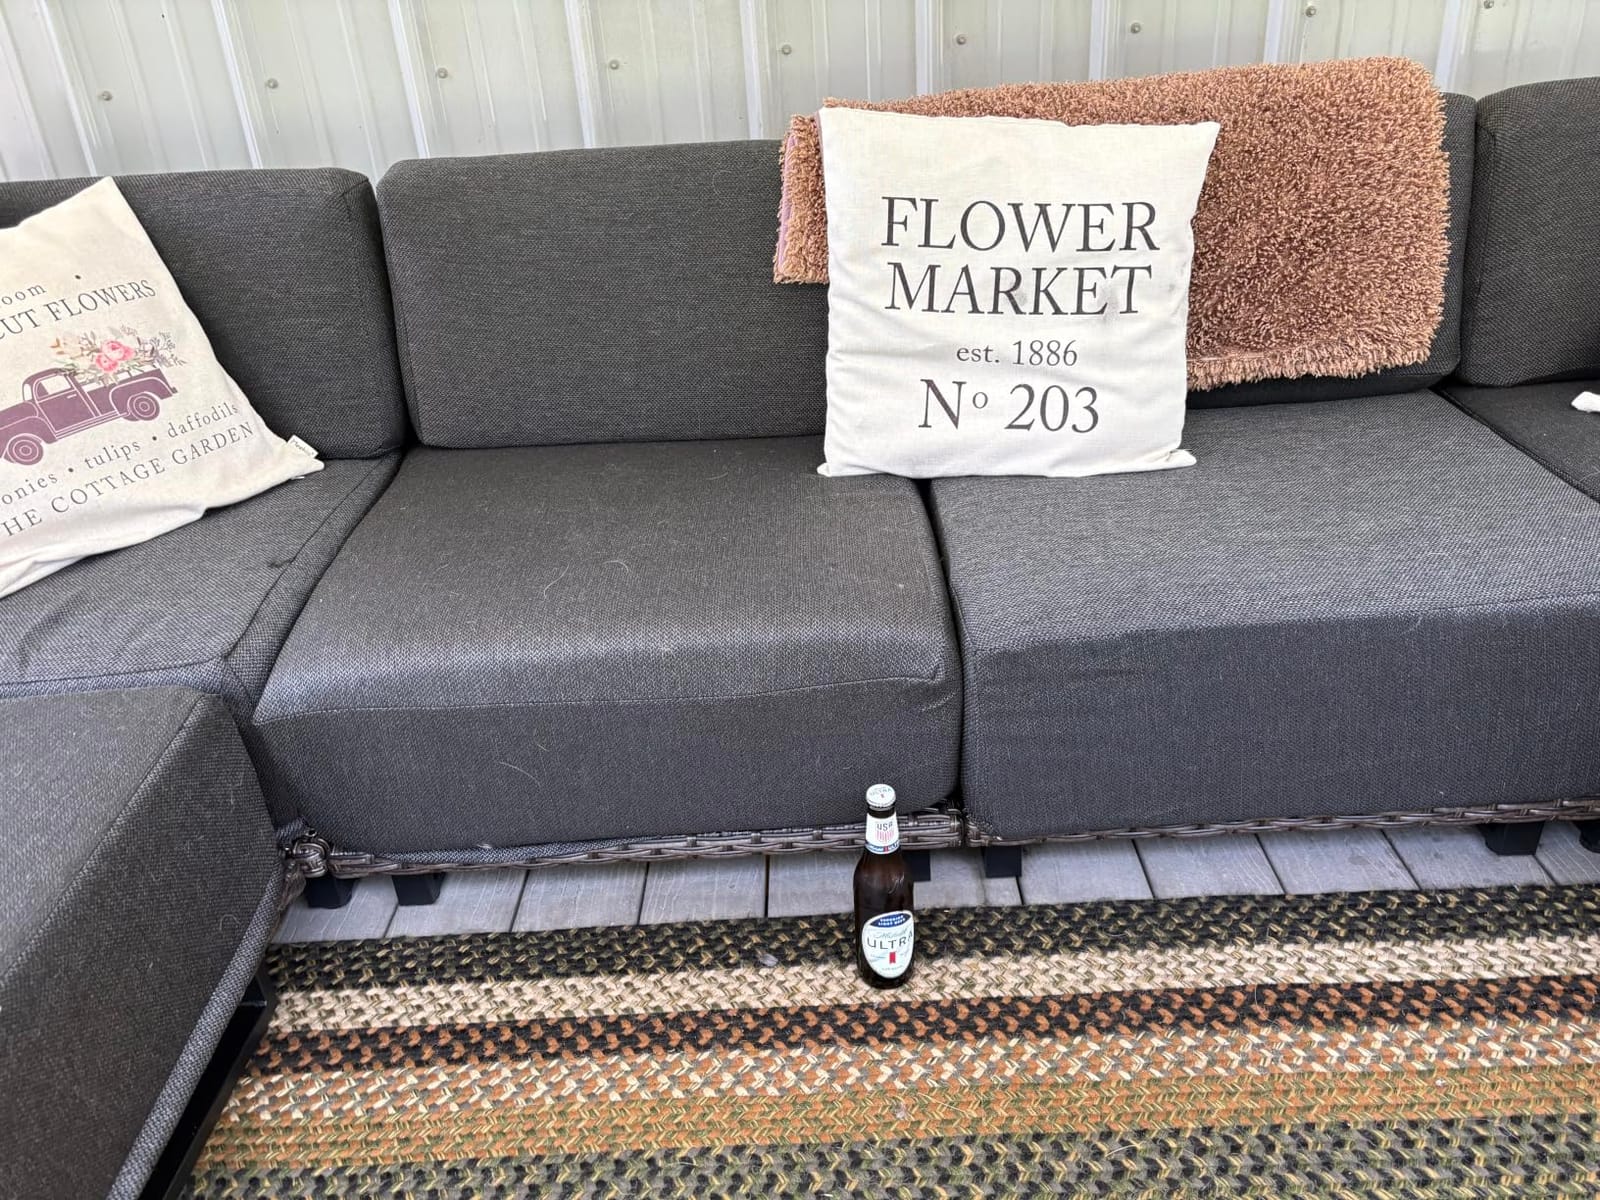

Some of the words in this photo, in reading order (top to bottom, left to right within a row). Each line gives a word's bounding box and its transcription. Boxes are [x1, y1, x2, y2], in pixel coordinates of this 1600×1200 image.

[880, 196, 1161, 253] FLOWER
[43, 279, 156, 322] FLOWERS
[884, 262, 1153, 317] MARKET
[956, 345, 1001, 364] est.
[1011, 339, 1079, 367] 1886
[1003, 383, 1100, 434] 203
[84, 441, 141, 469] tulips
[167, 402, 238, 439] daffodils
[51, 457, 166, 513] COTTAGE
[171, 421, 254, 465] GARDEN
[867, 930, 913, 950] ULTRA
